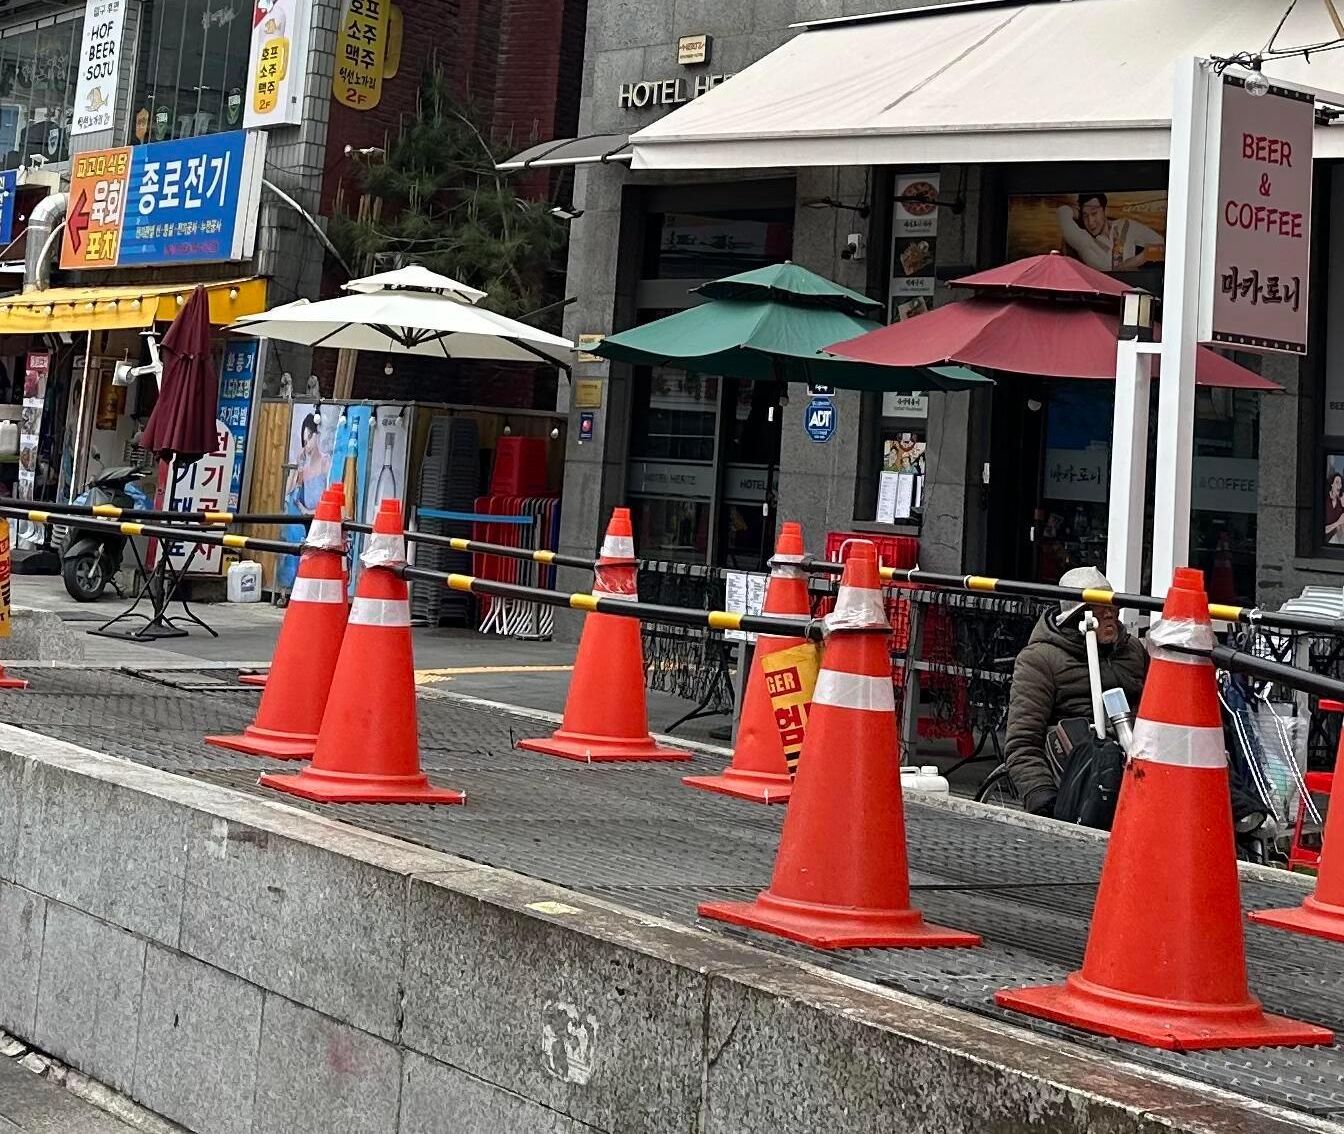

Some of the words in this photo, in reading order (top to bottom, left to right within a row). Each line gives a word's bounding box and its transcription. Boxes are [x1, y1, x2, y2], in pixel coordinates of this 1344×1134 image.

[90, 20, 115, 41] HOF
[346, 19, 377, 46] 소주
[88, 40, 115, 62] BEER
[261, 45, 279, 61] 호프
[345, 43, 375, 70] 맥주
[86, 60, 115, 81] SOJU
[259, 63, 277, 79] 소주
[258, 80, 276, 96] 맥주
[345, 88, 369, 105] 2F
[618, 77, 687, 109] HOTEL
[259, 98, 271, 110] 2F
[1242, 131, 1292, 168] BEER
[138, 150, 231, 216] 종로전기
[1258, 172, 1272, 197] &
[90, 178, 125, 227] 육회
[1224, 200, 1303, 239] COFFEE
[85, 230, 118, 262] 포차
[1221, 265, 1301, 312] 마카로니
[808, 410, 833, 428] ADT
[1207, 476, 1256, 492] COFFEE
